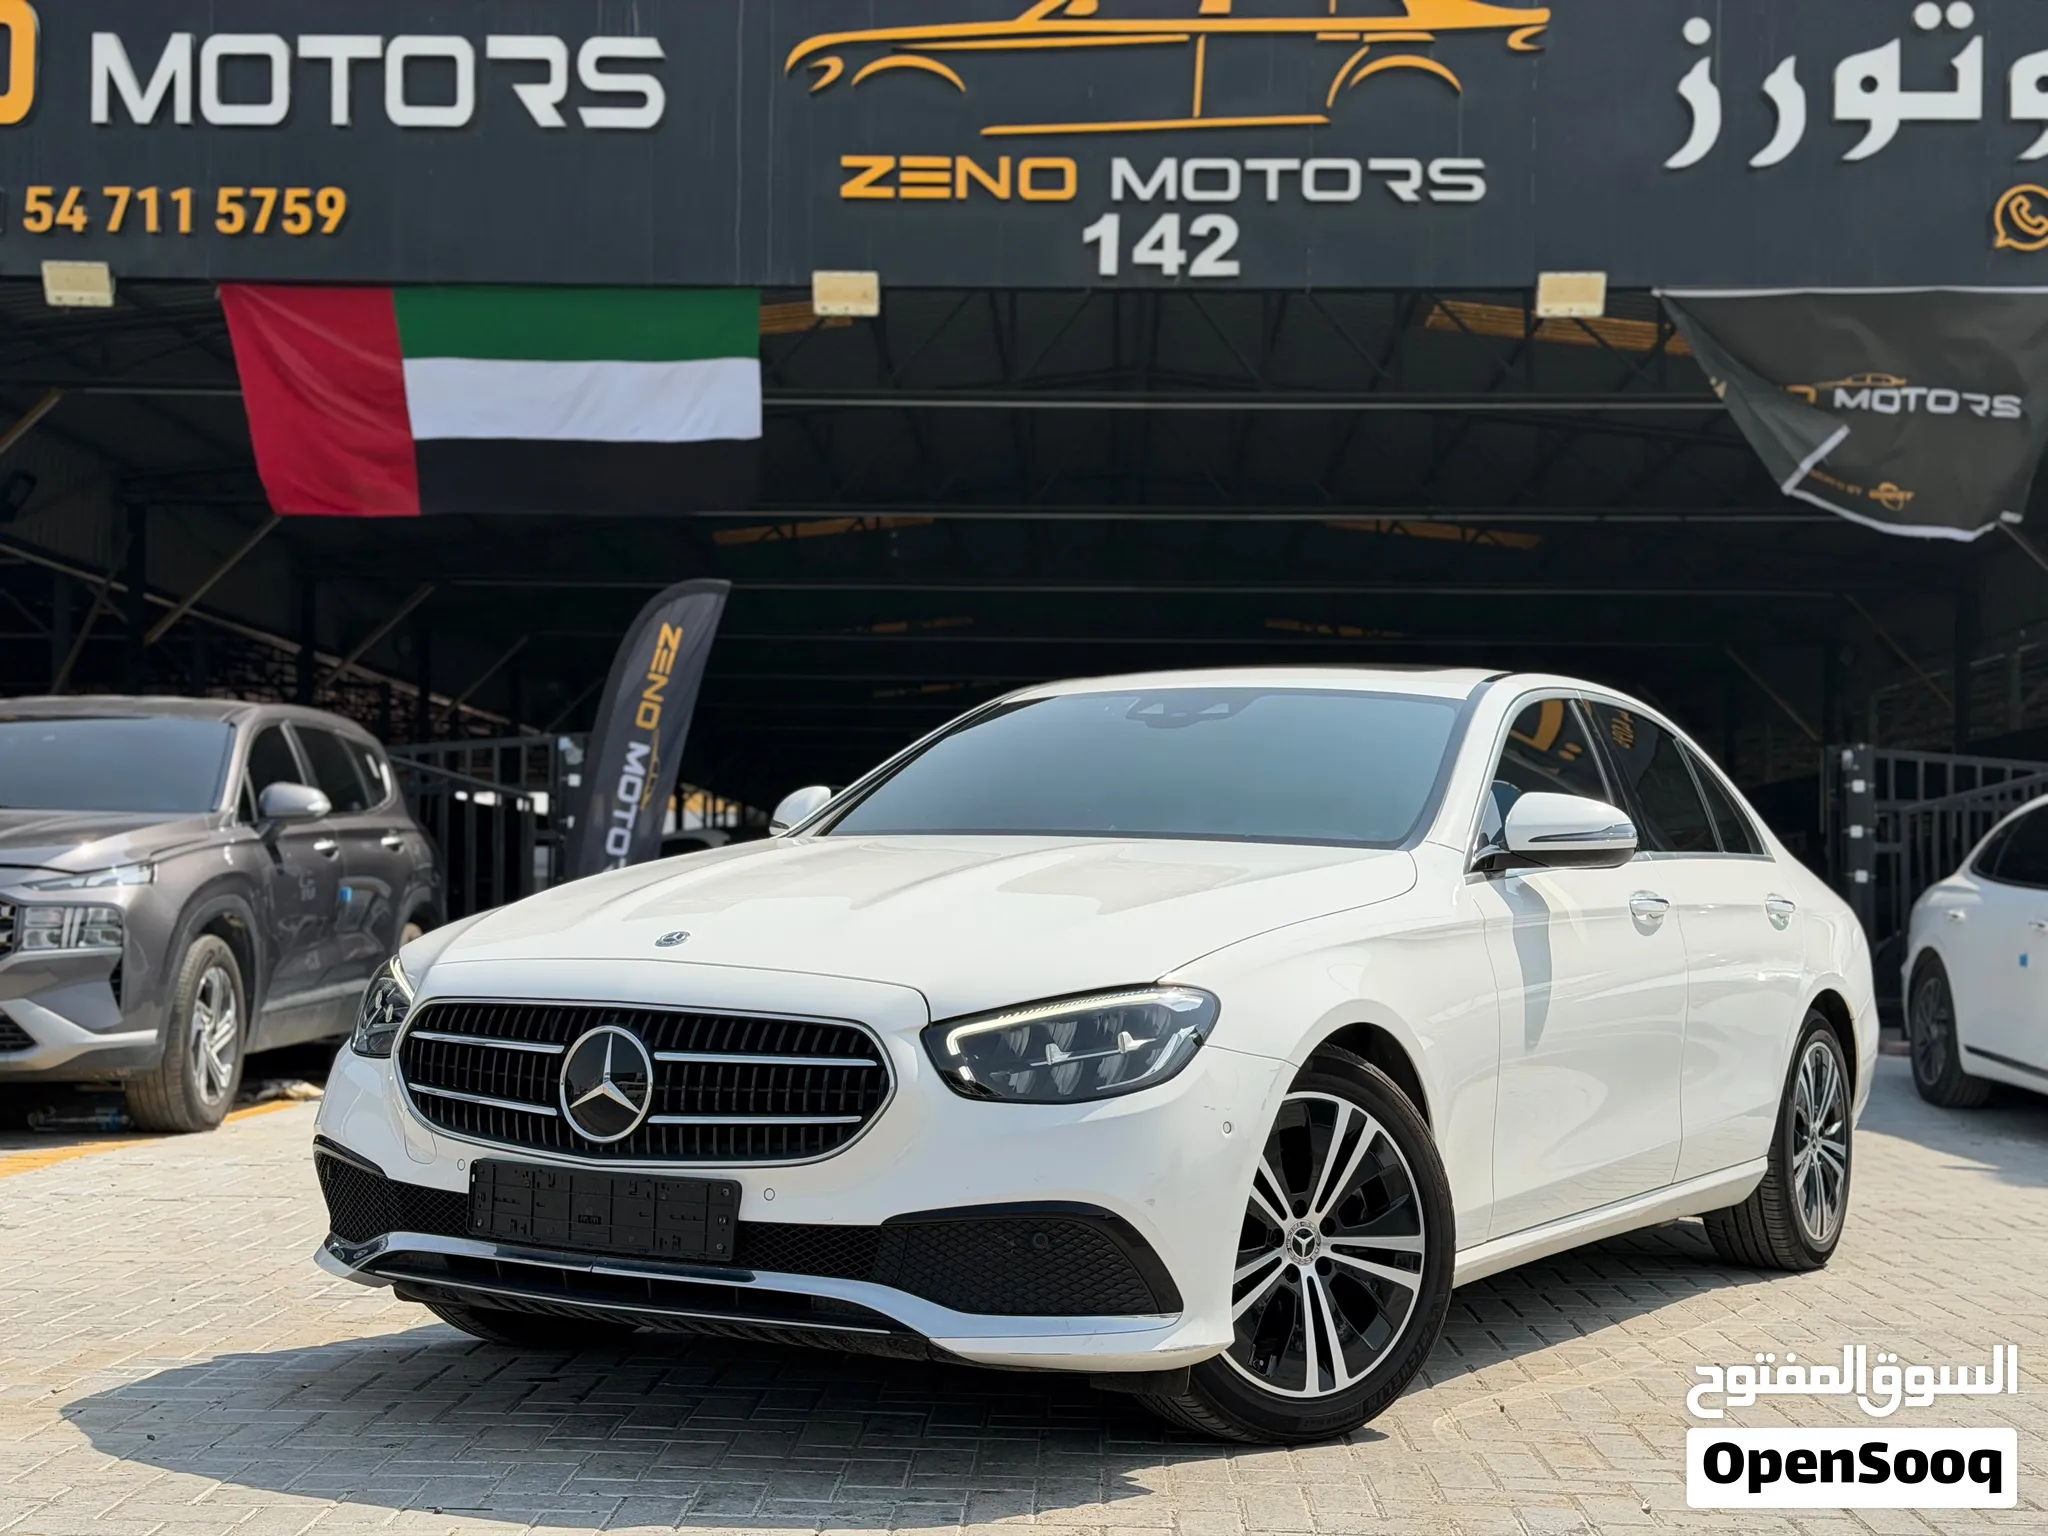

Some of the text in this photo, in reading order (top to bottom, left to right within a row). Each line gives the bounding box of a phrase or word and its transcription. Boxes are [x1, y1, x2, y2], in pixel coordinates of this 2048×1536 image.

[91, 32, 665, 128] MOTORS
[840, 155, 1487, 201] ZENO MOTORS
[23, 186, 347, 235] 54 711 5759
[1082, 213, 1240, 276] 142
[1834, 387, 2022, 418] MOTORS
[635, 622, 683, 730] ZENO
[1364, 1325, 1433, 1412] MICHELIN
